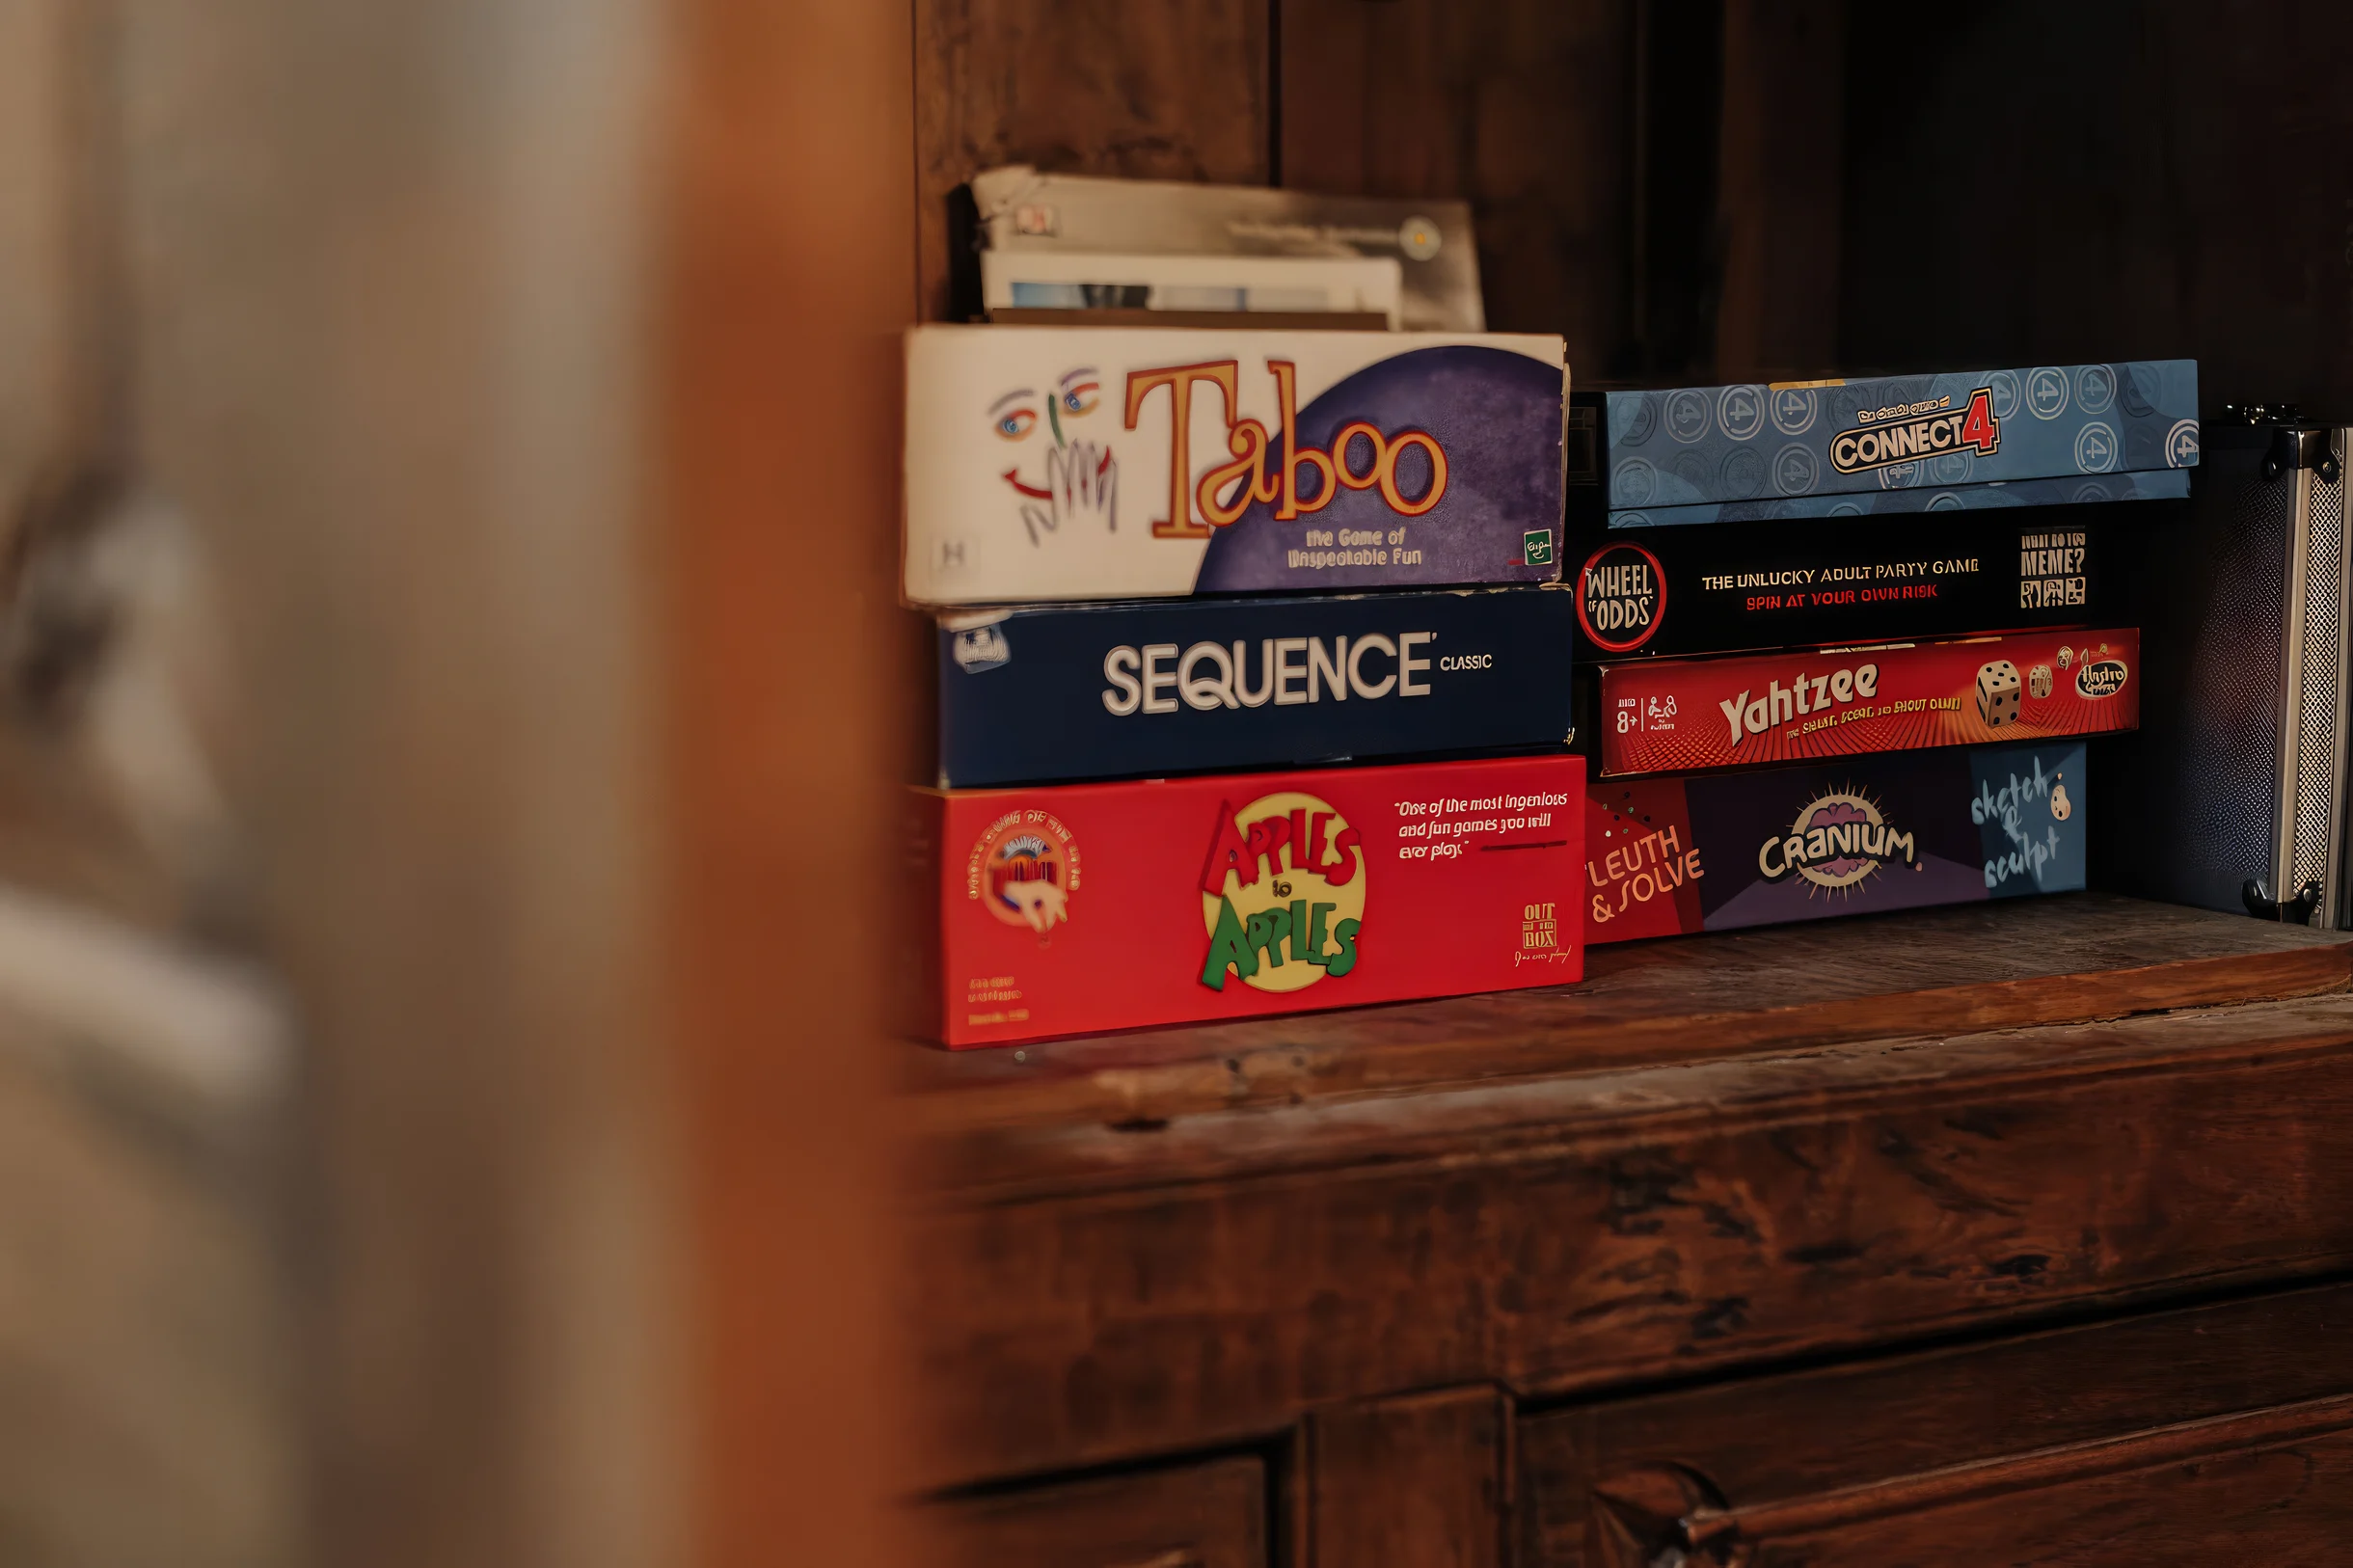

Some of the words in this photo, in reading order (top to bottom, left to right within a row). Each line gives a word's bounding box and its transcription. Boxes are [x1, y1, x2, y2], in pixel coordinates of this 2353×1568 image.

[1124, 359, 1447, 539] Taboo
[1835, 415, 1962, 467] CONNECT
[1962, 394, 1994, 449] 4
[1338, 527, 1383, 547] Game
[1388, 526, 1406, 545] of
[1393, 547, 1422, 565] Fun
[1586, 565, 1652, 598] WHEEL
[1702, 576, 1734, 590] THE
[1737, 570, 1815, 587] UNLUCKY
[1821, 566, 1872, 582] ADULT
[1876, 561, 1928, 579] PARTY
[1786, 594, 1805, 608] AT
[1811, 589, 1855, 606] YOUR
[1861, 587, 1899, 602] OWN
[1903, 583, 1938, 599] RISK
[1597, 596, 1650, 631] ODDS
[1102, 631, 1434, 716] SEQUENCE
[1440, 654, 1493, 671] CLASSIC
[1719, 663, 1879, 747] Yahtzee
[1429, 798, 1445, 817] of
[1470, 796, 1501, 811] most
[1971, 755, 2047, 825] sketch
[1202, 799, 1361, 899] APPLES
[1426, 821, 1450, 839] fun
[1587, 825, 1680, 886] LEUTH
[1985, 825, 2060, 888] sculpt
[1592, 894, 1615, 923] &
[1619, 848, 1704, 912] SOLVE
[1525, 903, 1555, 920] OUT
[1202, 897, 1362, 993] APPLES
[1525, 931, 1554, 947] BOX
